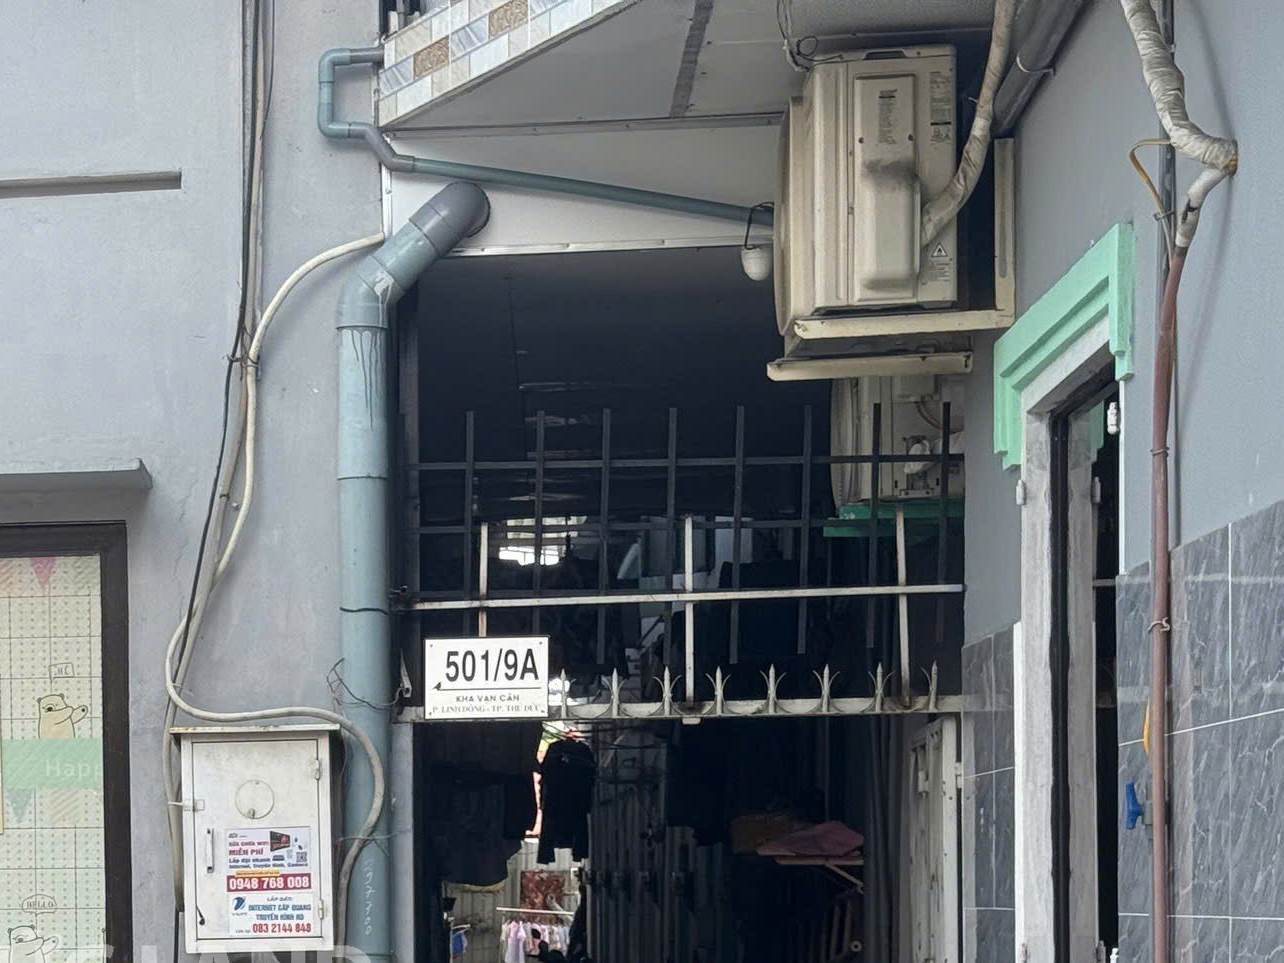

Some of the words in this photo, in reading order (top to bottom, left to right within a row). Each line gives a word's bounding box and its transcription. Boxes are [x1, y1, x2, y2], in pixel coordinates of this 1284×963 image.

[445, 648, 539, 682] 501/9A
[456, 694, 474, 703] KHA
[229, 877, 259, 890] 0948
[260, 876, 284, 889] 768
[287, 876, 310, 888] 008
